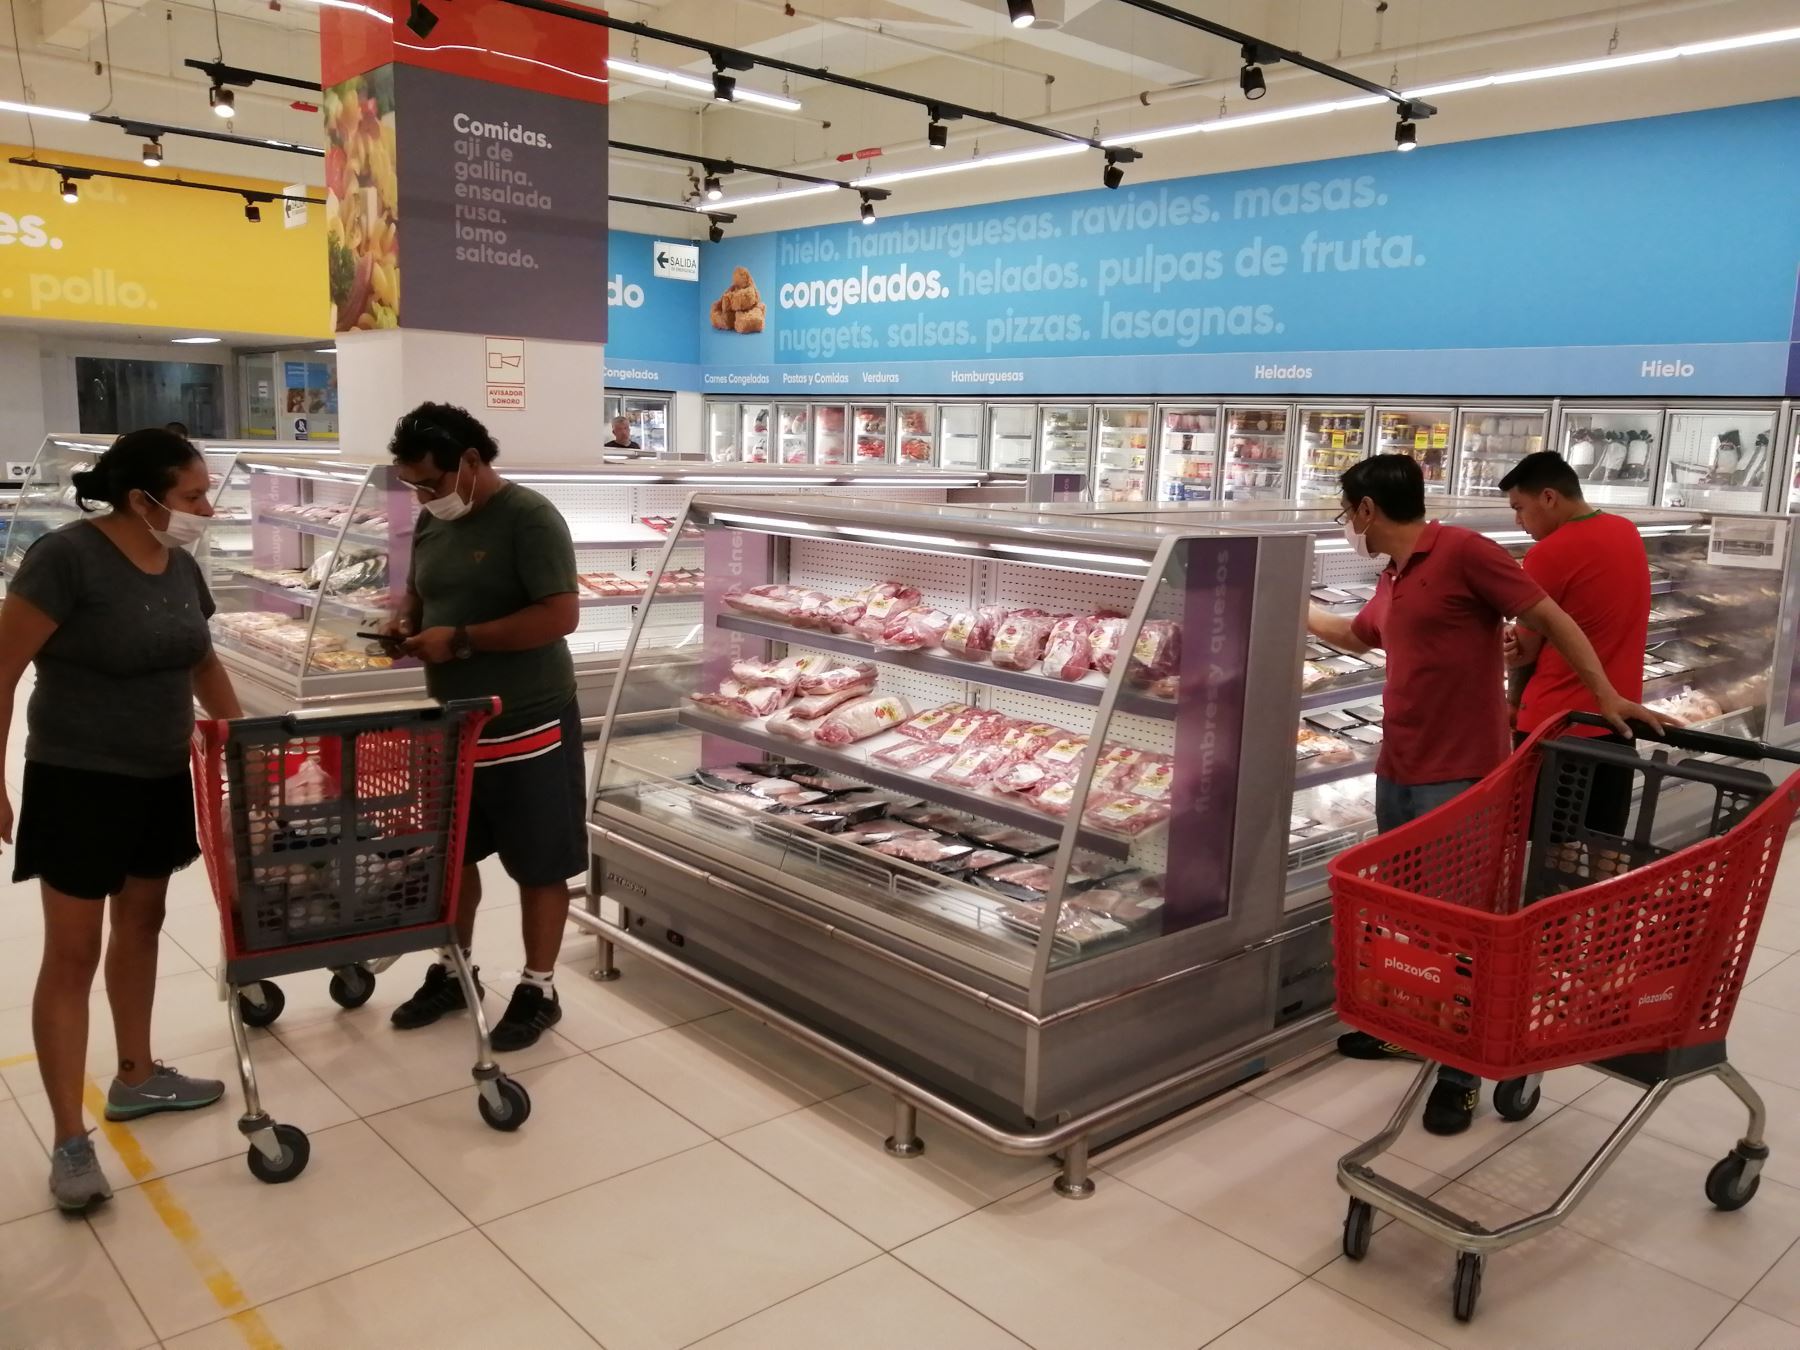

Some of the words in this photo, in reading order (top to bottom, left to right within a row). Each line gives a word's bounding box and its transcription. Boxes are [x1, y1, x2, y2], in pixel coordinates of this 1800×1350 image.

[453, 113, 552, 149] Comidas.
[486, 142, 513, 162] de
[454, 160, 533, 187] gallina.
[454, 182, 552, 209] ensalada
[455, 203, 507, 224] rusa.
[780, 231, 840, 266] hielo.
[847, 210, 1061, 258] hamburguesas.
[1071, 187, 1221, 237] ravioles.
[1233, 175, 1388, 220] masas.
[455, 219, 507, 244] lomo
[455, 244, 539, 269] saltado.
[670, 256, 697, 268] SALIDA
[779, 262, 950, 316] congelados.
[958, 255, 1087, 296] helados.
[1098, 243, 1224, 296] pulpas
[1235, 236, 1288, 278] de
[1301, 230, 1426, 273] fruta.
[30, 267, 158, 312] pollo.
[779, 320, 879, 359] nuggets.
[887, 312, 977, 349] salsas.
[985, 307, 1090, 353] pizzas.
[1100, 300, 1286, 348] lasagnas.
[704, 373, 728, 385] Carnes
[782, 373, 807, 385] Pastas
[808, 375, 814, 386] y
[814, 372, 849, 384] Comidas
[862, 371, 899, 384] Verduras
[951, 370, 1024, 385] Hamburguesas
[1254, 364, 1313, 381] Helados
[1641, 359, 1695, 377] Hielo
[1210, 550, 1230, 652] quesos
[1384, 956, 1441, 984] plazavea
